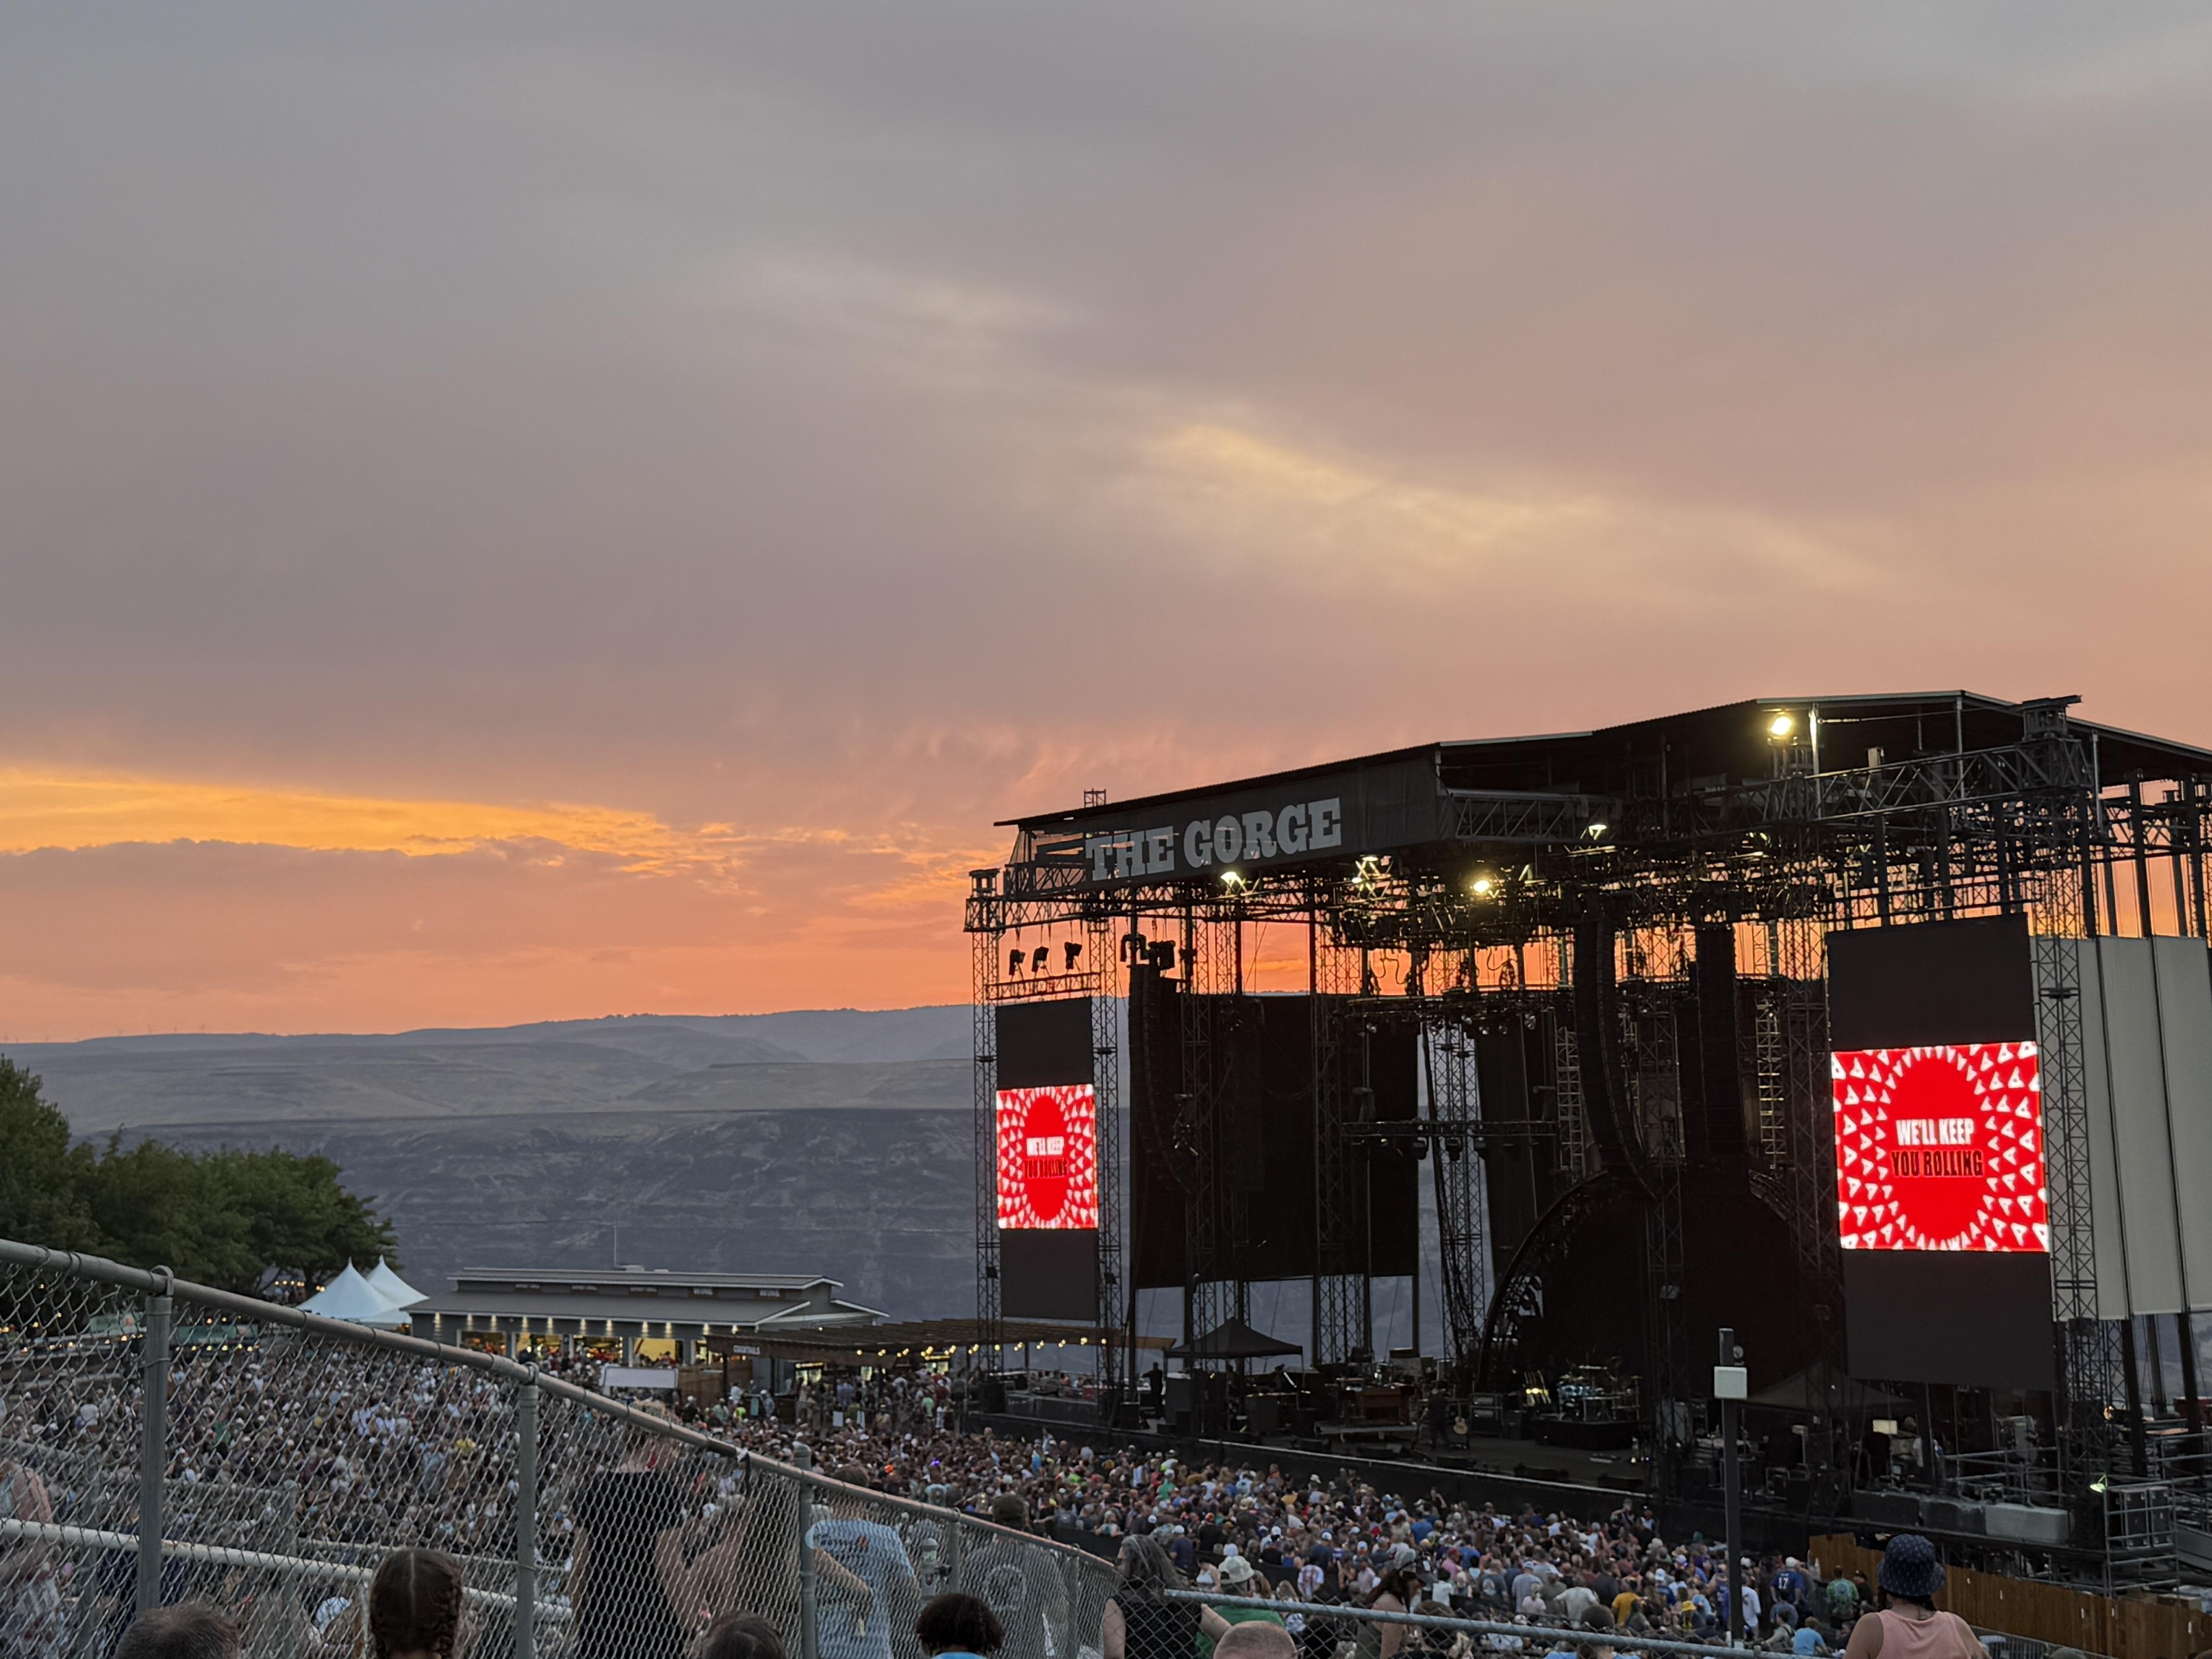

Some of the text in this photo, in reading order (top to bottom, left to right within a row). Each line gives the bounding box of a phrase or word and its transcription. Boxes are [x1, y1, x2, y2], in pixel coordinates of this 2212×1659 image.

[1085, 797, 1341, 881] THE GORGE
[1896, 1118, 1974, 1146] WE'LL KEEP
[1891, 1150, 1983, 1176] YOU ROLLING
